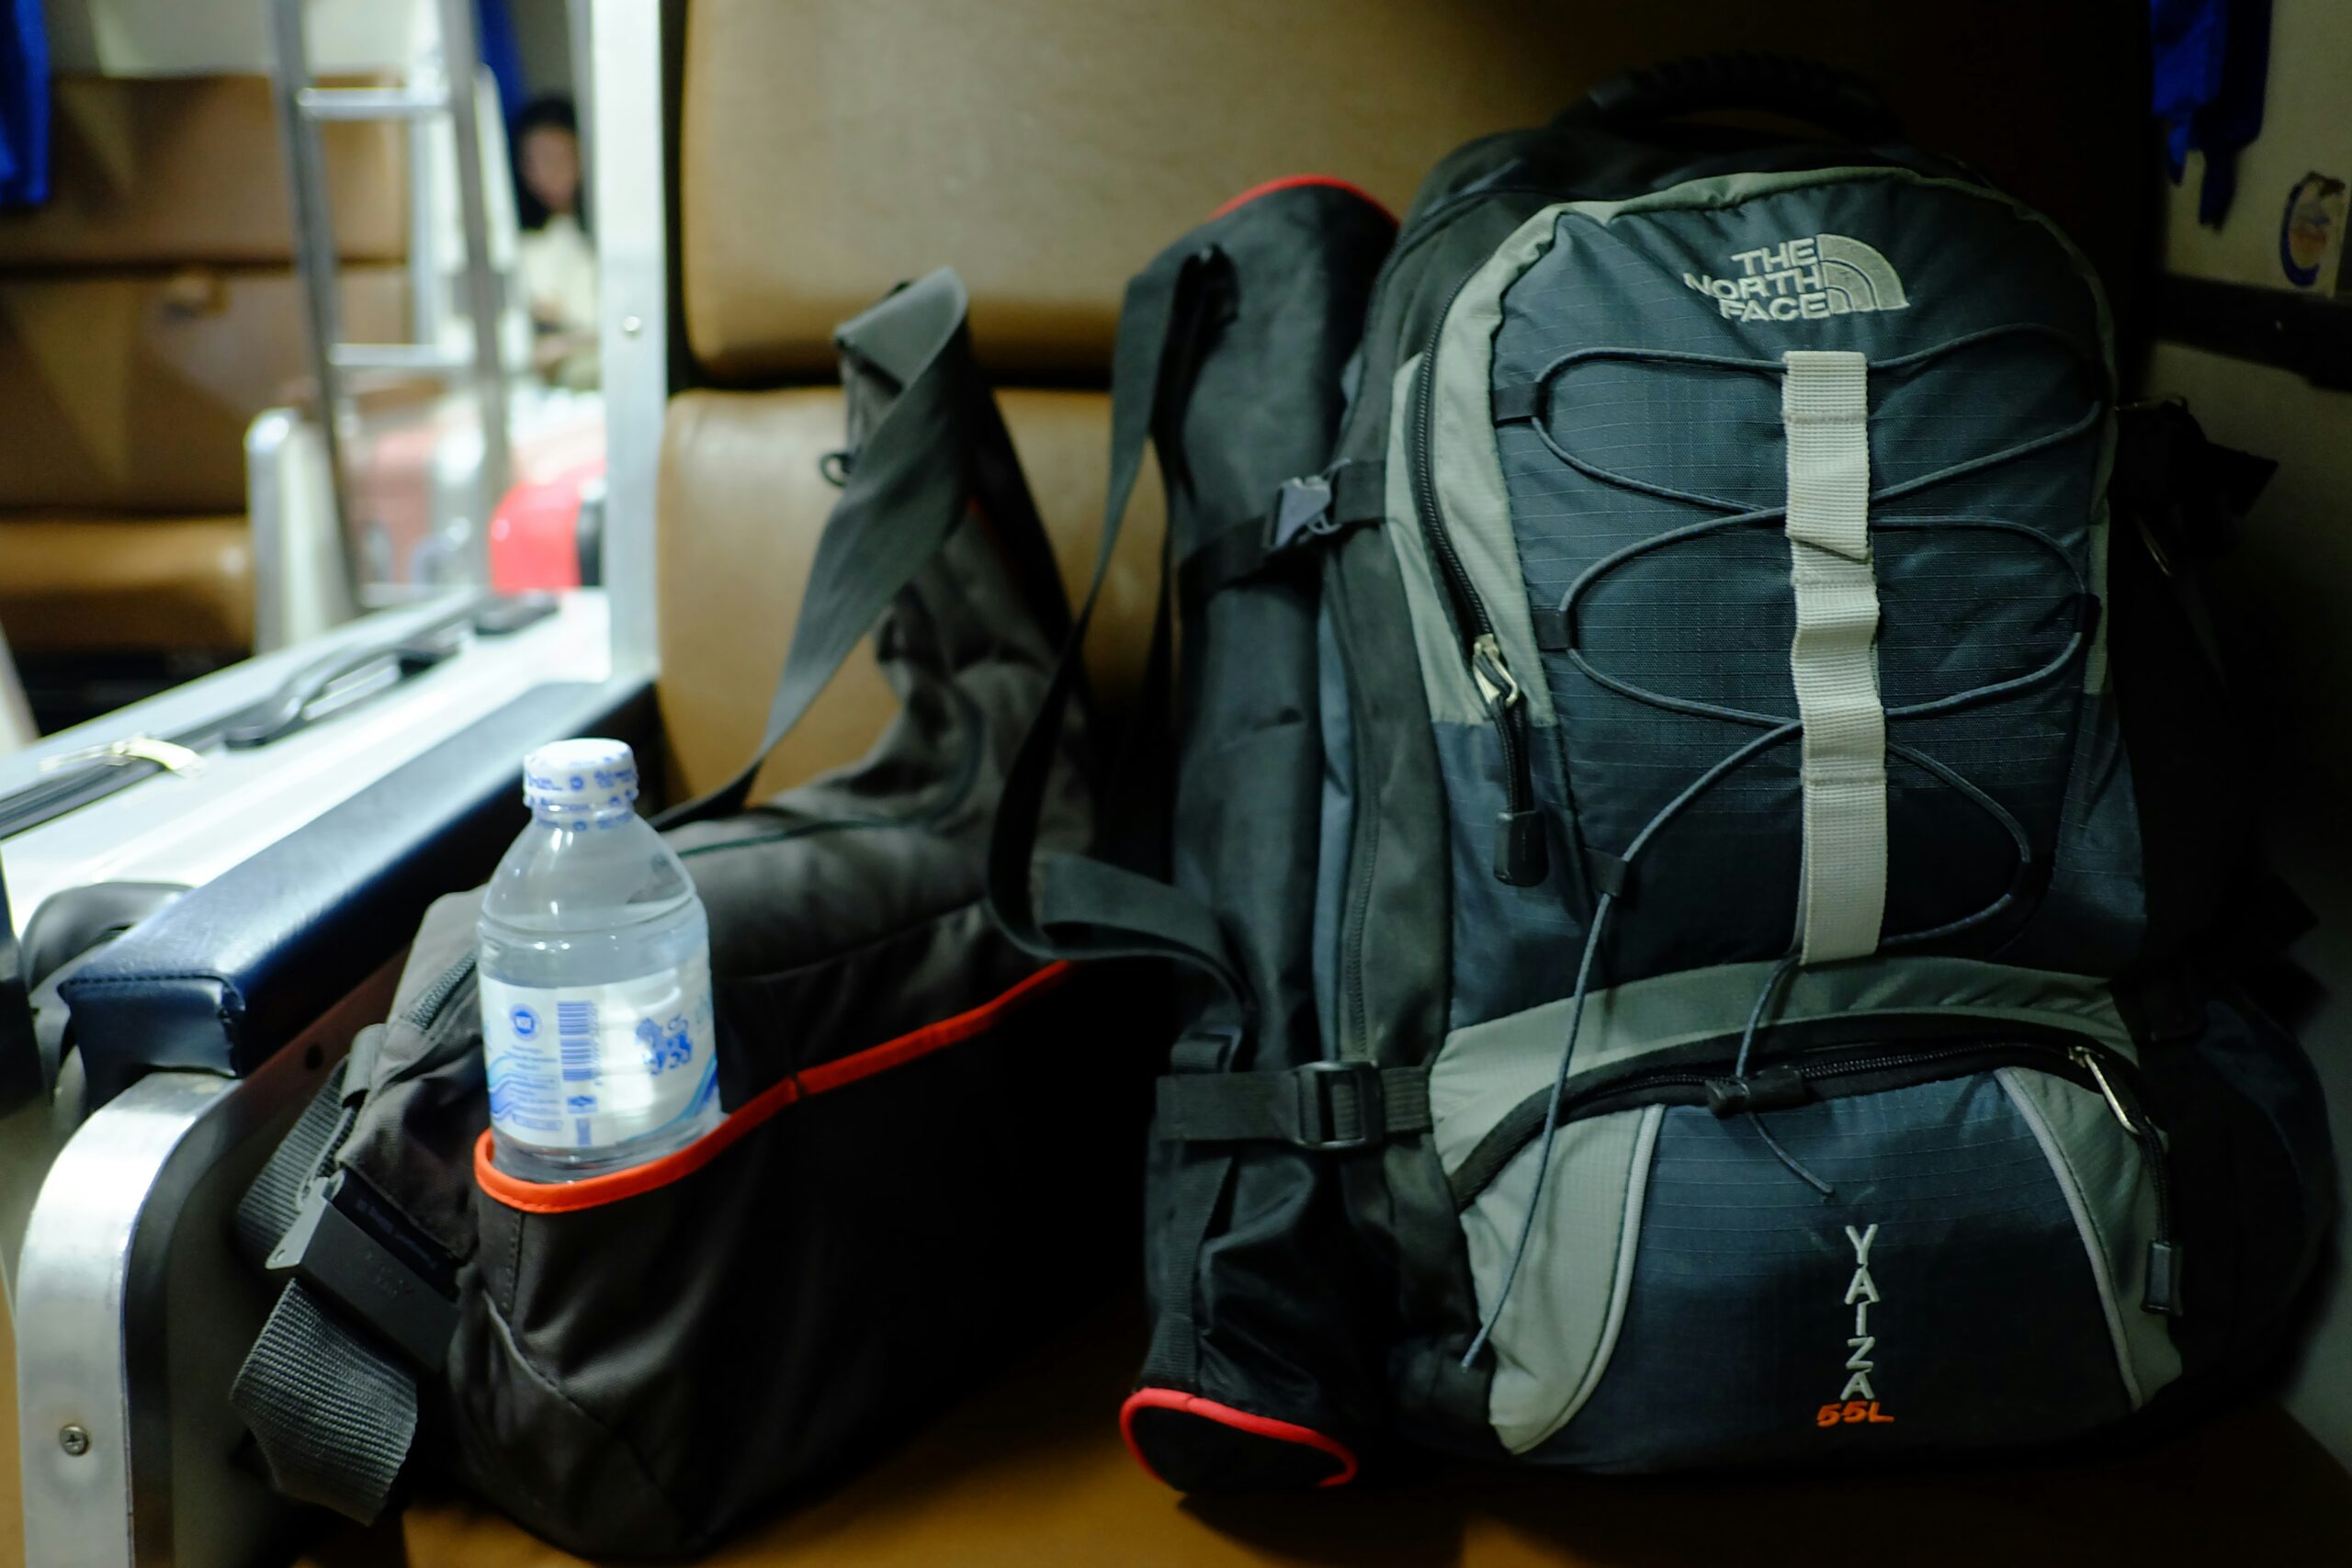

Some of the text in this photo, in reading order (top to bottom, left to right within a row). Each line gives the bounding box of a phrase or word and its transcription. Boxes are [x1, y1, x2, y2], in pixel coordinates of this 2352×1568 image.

[1730, 238, 1817, 276] THE
[1683, 263, 1824, 301] NORTH
[1719, 291, 1831, 321] FACE
[1840, 1224, 1880, 1401] YAIZA
[1816, 1401, 1895, 1427] 55L
